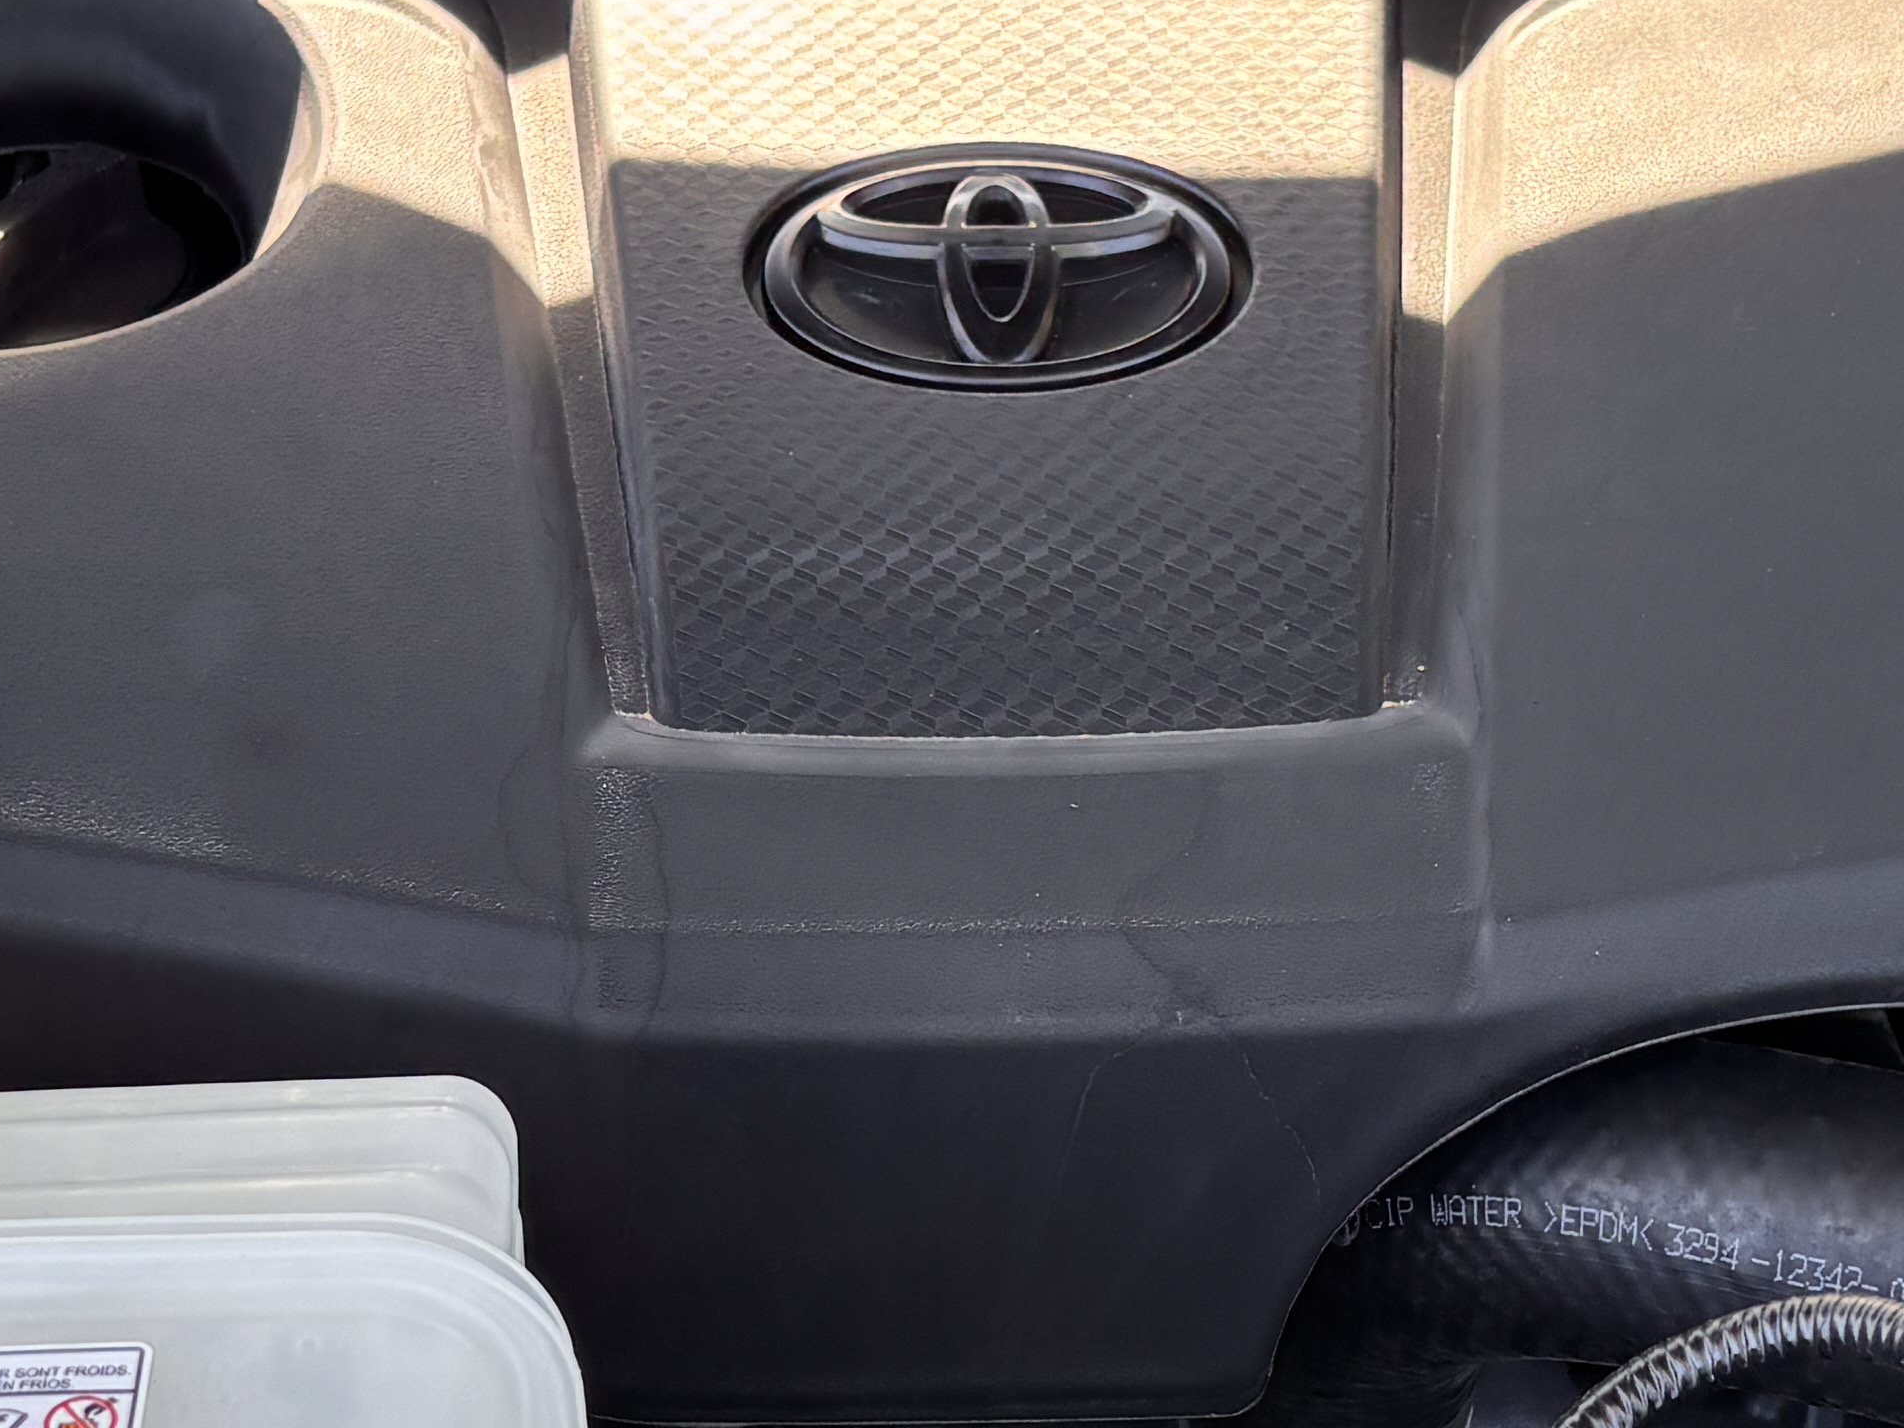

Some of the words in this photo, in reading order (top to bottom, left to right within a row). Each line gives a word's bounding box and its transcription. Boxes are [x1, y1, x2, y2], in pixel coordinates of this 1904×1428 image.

[1364, 1195, 1414, 1229] CIP
[1430, 1193, 1522, 1229] WATER
[1664, 1222, 1739, 1271] 3294
[13, 1367, 62, 1378] SONT
[64, 1365, 133, 1376] FROIDS.
